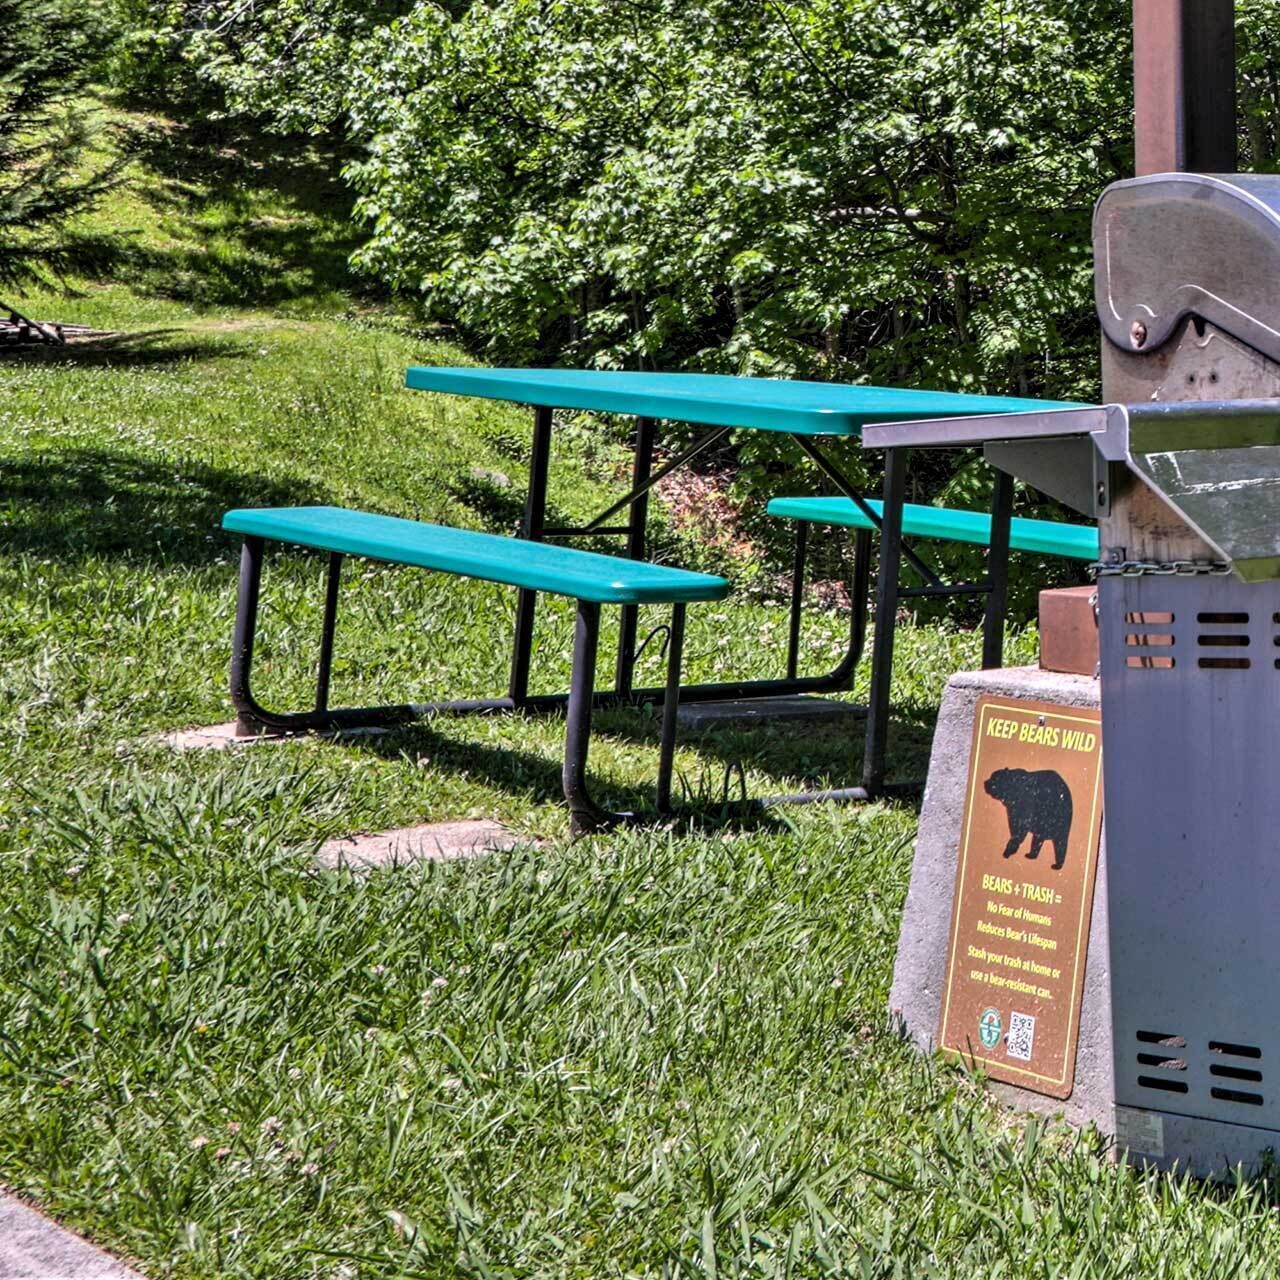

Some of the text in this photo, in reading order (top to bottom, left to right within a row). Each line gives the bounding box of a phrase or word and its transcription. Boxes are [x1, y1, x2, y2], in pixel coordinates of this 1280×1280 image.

[987, 717, 1096, 752] KEEP BEARS WILD
[982, 874, 1062, 904] BEARS + TRASH =
[987, 901, 1052, 926] No Fear of Humans
[977, 920, 1057, 950] Reduces Bear's Lifespan
[968, 945, 1061, 979] Stash your trash at home or
[971, 970, 983, 982] use
[984, 974, 989, 983] a
[989, 972, 1037, 996] bear-resistant
